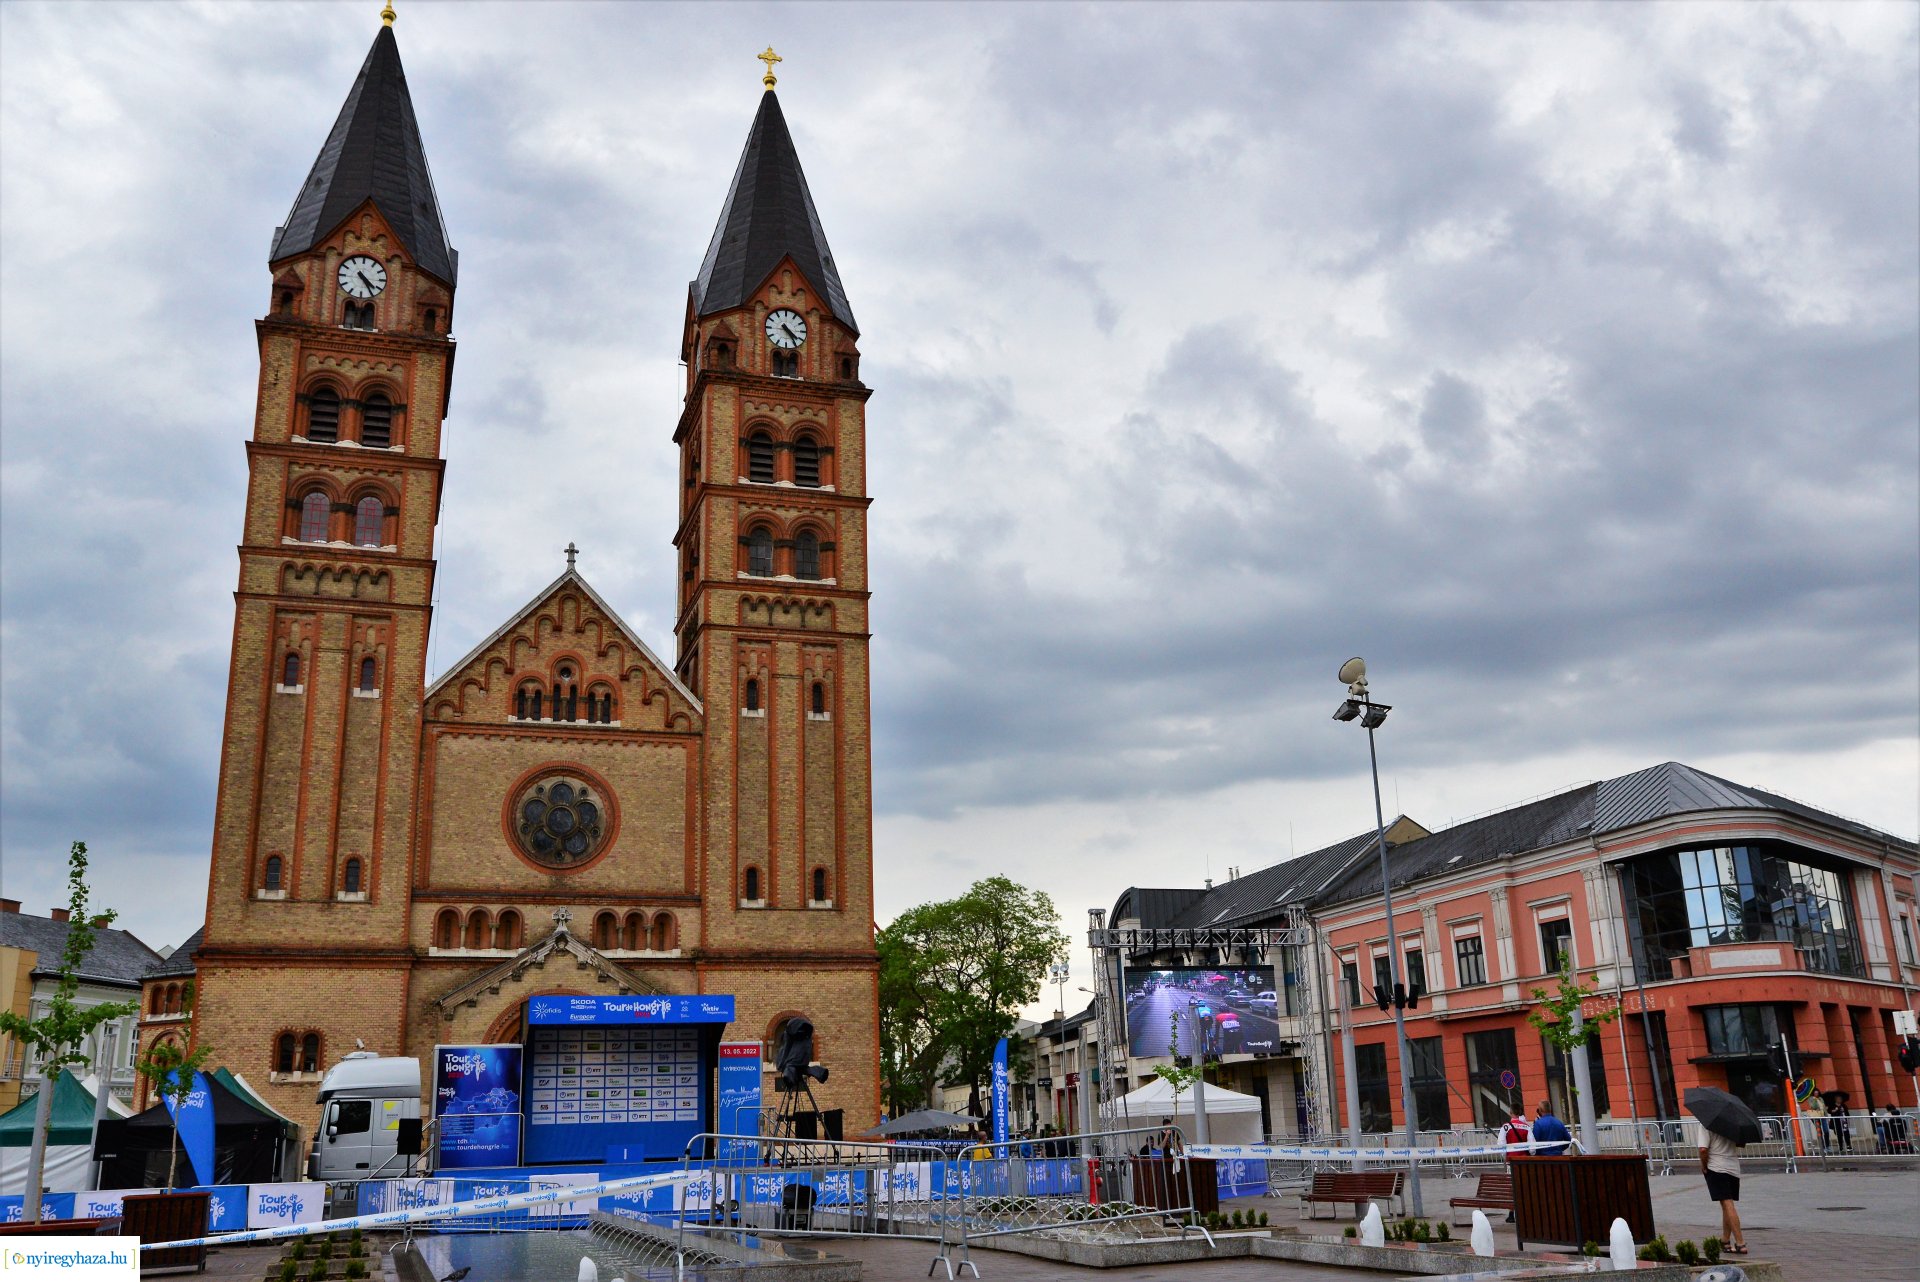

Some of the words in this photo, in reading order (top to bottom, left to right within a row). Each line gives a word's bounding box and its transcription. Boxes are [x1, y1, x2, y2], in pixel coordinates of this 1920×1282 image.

[445, 1054, 470, 1063] Tour
[259, 1194, 287, 1204] Tour
[88, 1203, 117, 1212] Tour
